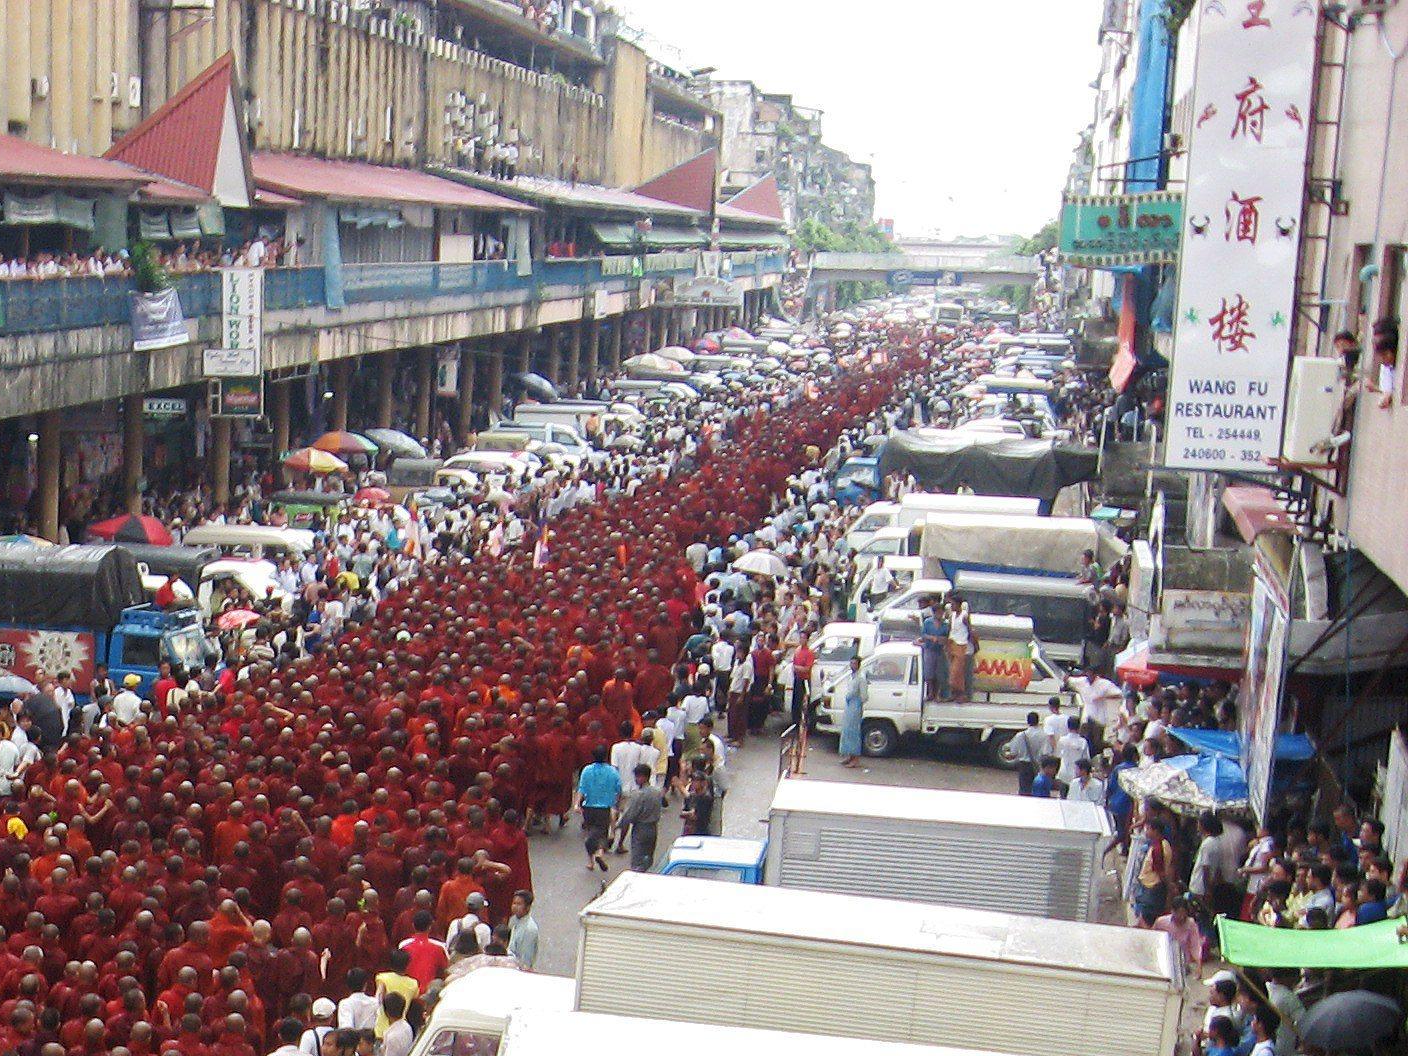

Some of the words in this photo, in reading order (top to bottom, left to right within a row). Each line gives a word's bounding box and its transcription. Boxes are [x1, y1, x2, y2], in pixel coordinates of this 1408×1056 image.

[1188, 379, 1237, 396] WANG
[1248, 381, 1269, 396] FU
[1175, 402, 1278, 421] RESTAURANT
[1185, 426, 1205, 438] TEL
